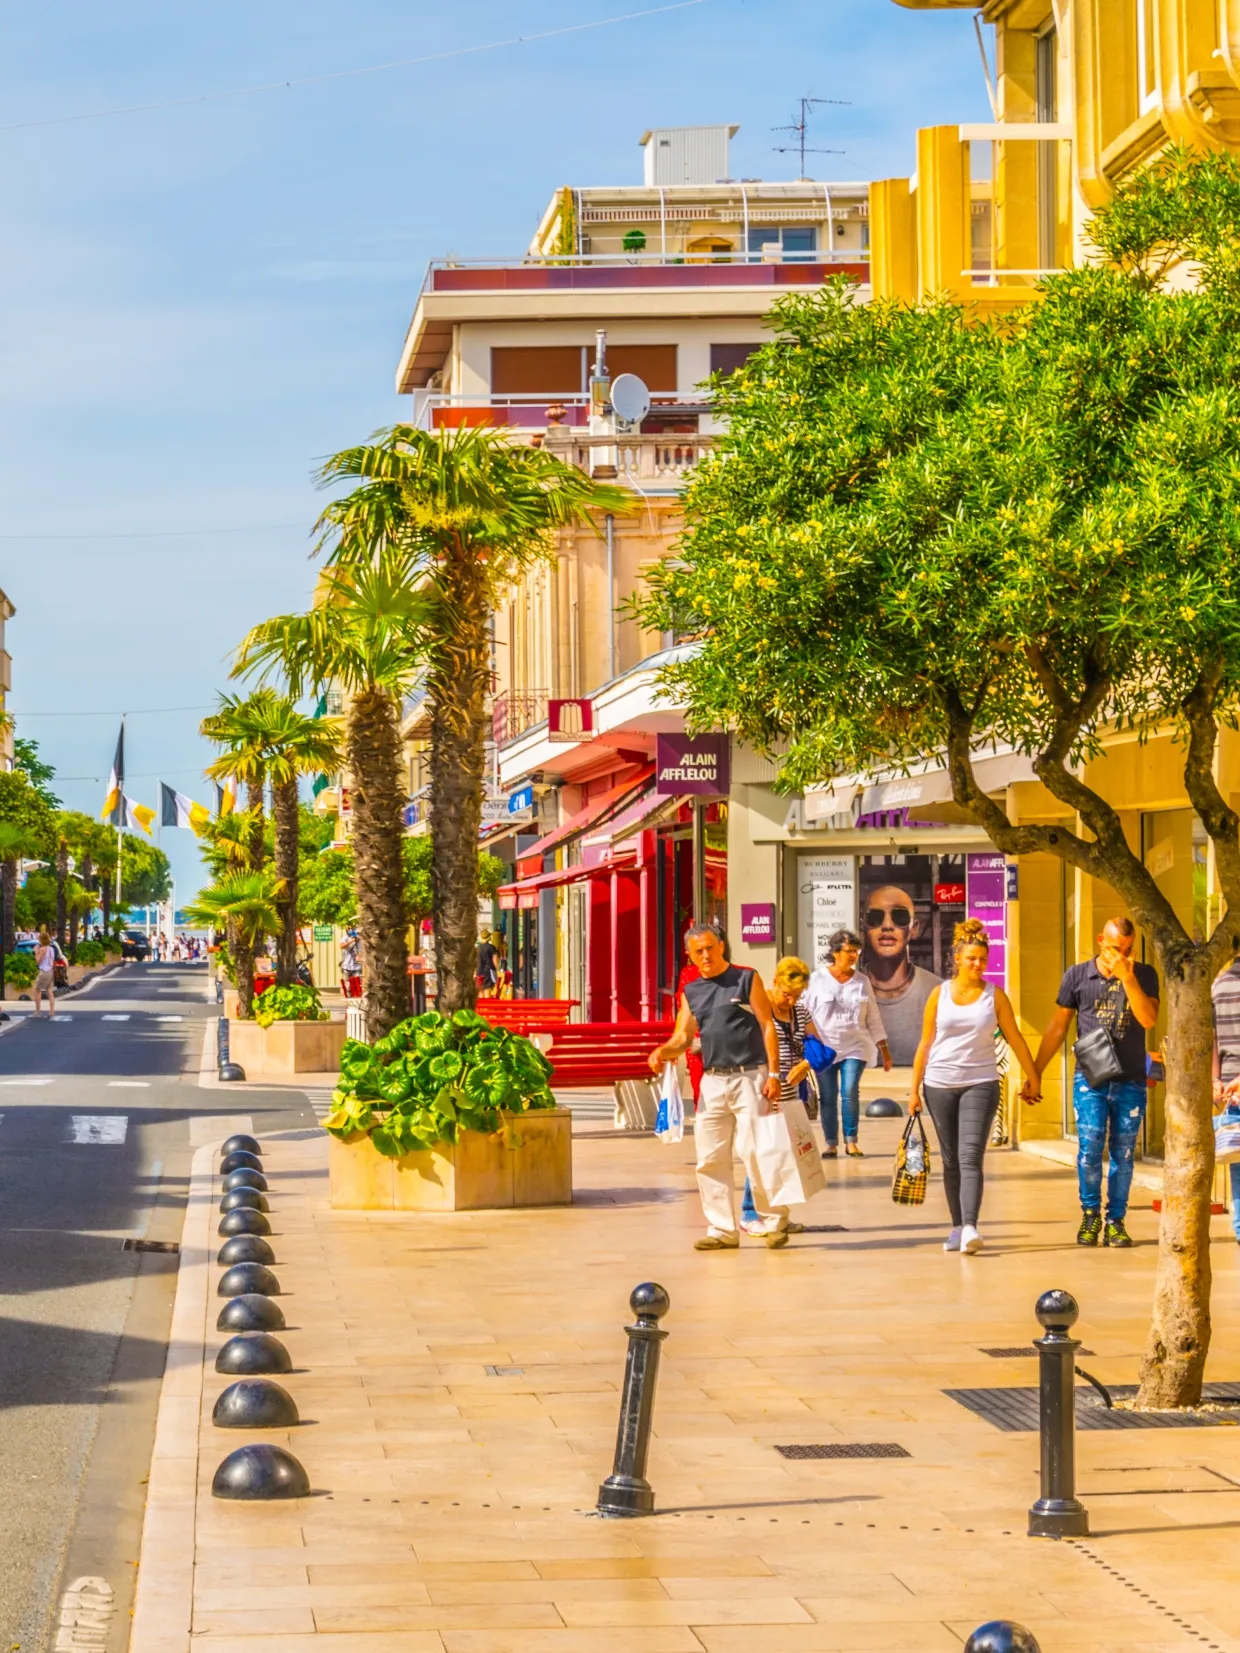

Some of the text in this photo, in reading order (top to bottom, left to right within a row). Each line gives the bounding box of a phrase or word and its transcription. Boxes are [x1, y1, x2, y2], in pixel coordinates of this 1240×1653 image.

[680, 753, 717, 766] ALAIN
[659, 767, 717, 781] AFFLELOU
[989, 858, 1005, 868] AFFL
[817, 898, 837, 906] Chloé
[751, 916, 770, 925] ALAIN
[742, 925, 770, 934] AFFLELOU
